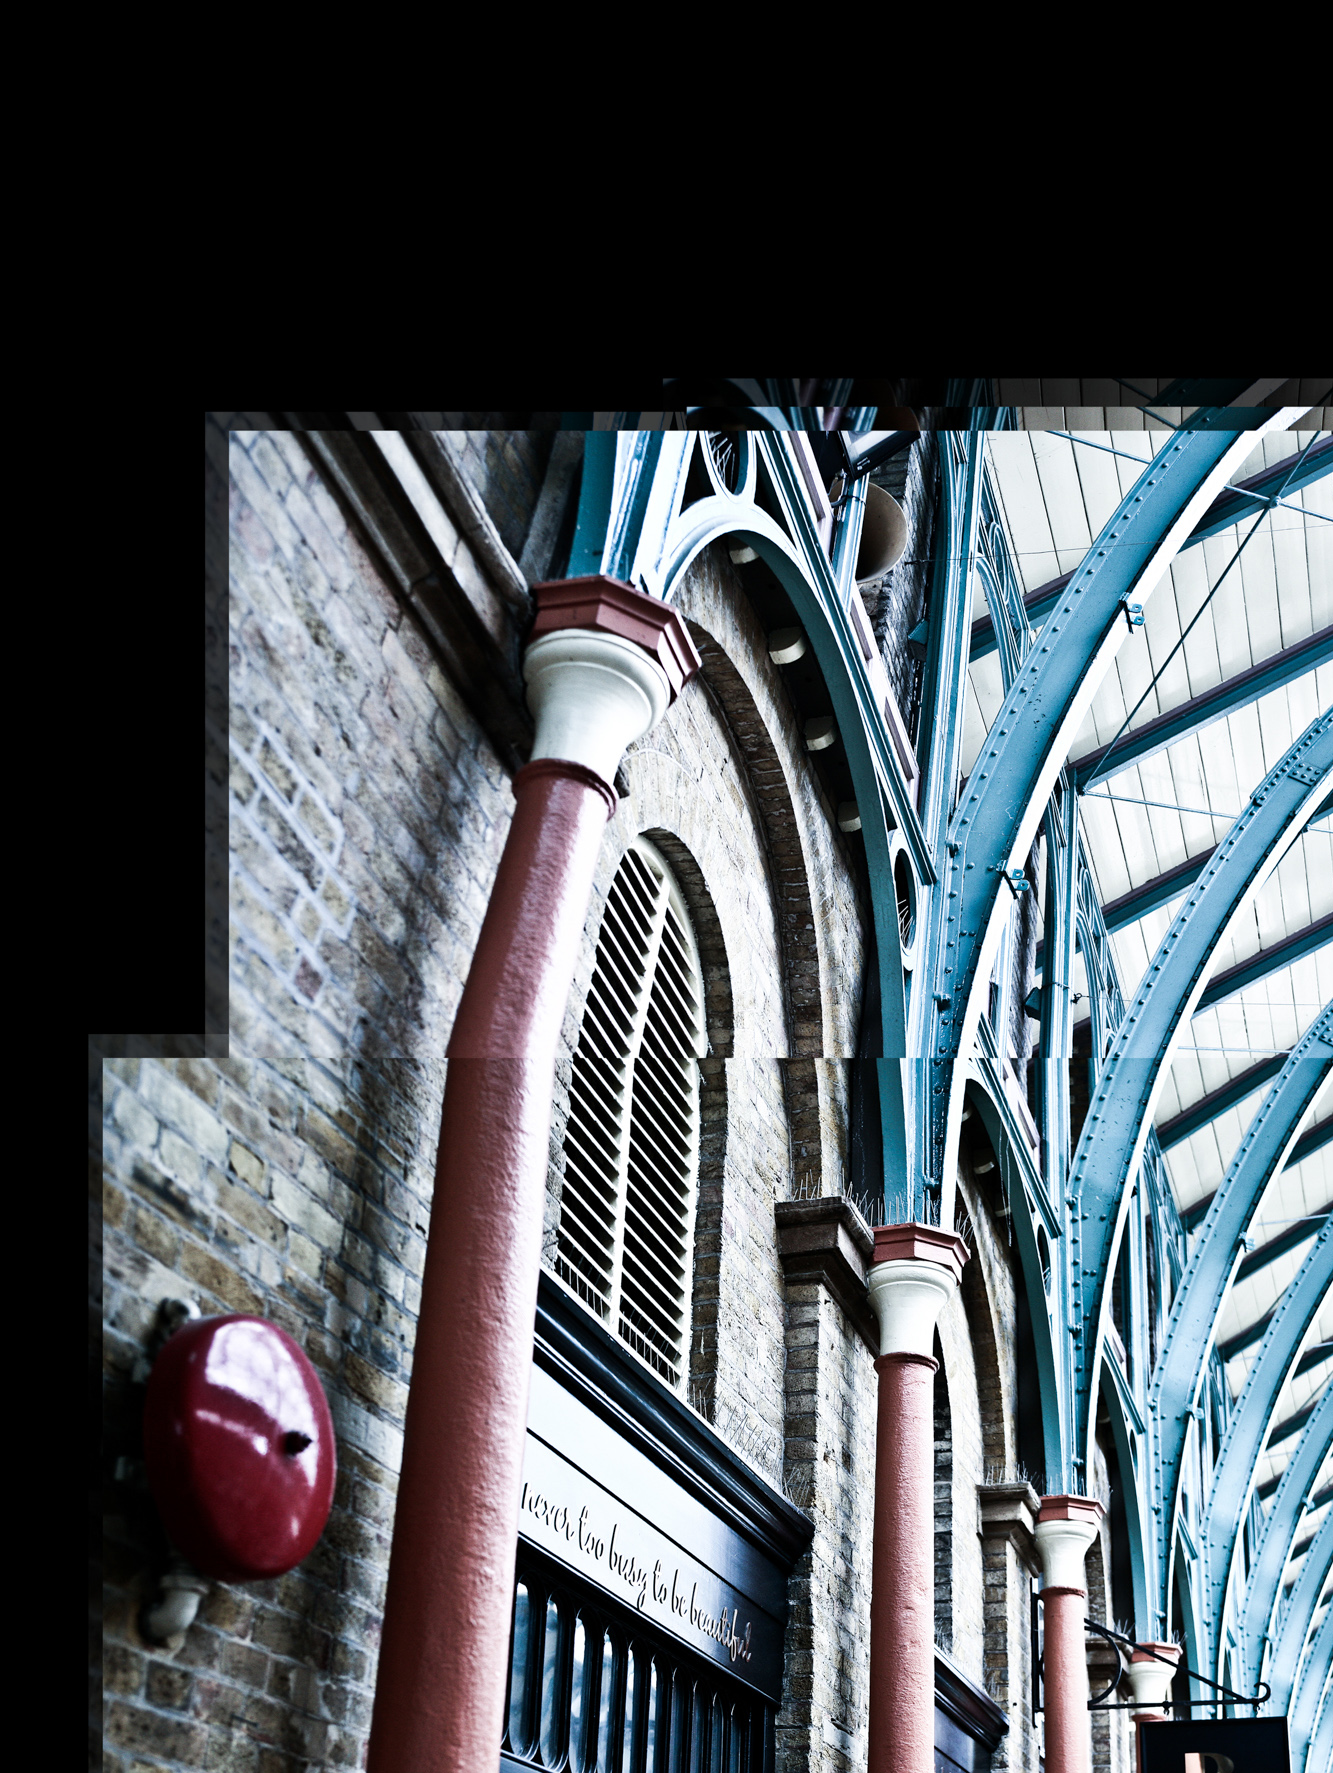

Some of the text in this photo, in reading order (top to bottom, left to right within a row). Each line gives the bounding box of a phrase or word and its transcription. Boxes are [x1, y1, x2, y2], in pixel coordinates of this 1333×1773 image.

[521, 1482, 752, 1662] never too busy to be beautiful
